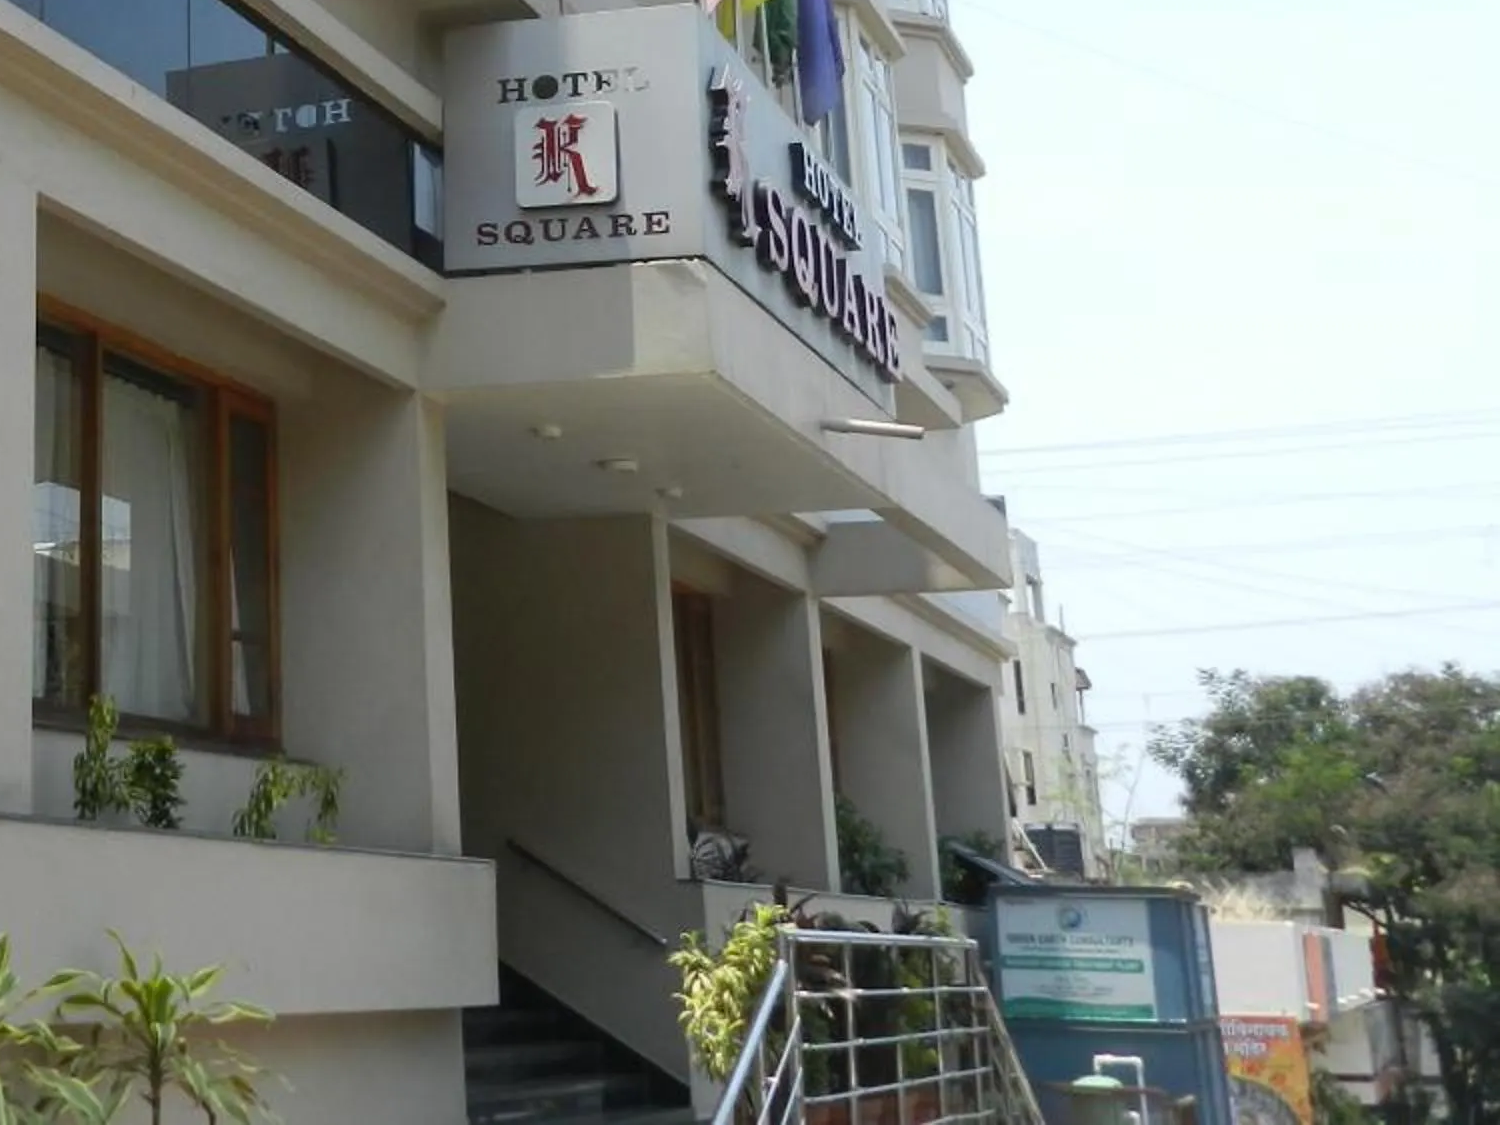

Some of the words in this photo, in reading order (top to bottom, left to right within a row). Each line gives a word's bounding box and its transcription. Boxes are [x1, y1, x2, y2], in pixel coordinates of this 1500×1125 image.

[476, 211, 671, 247] SQUARE
[792, 143, 863, 251] HOTEL
[756, 178, 903, 382] SQUARE
